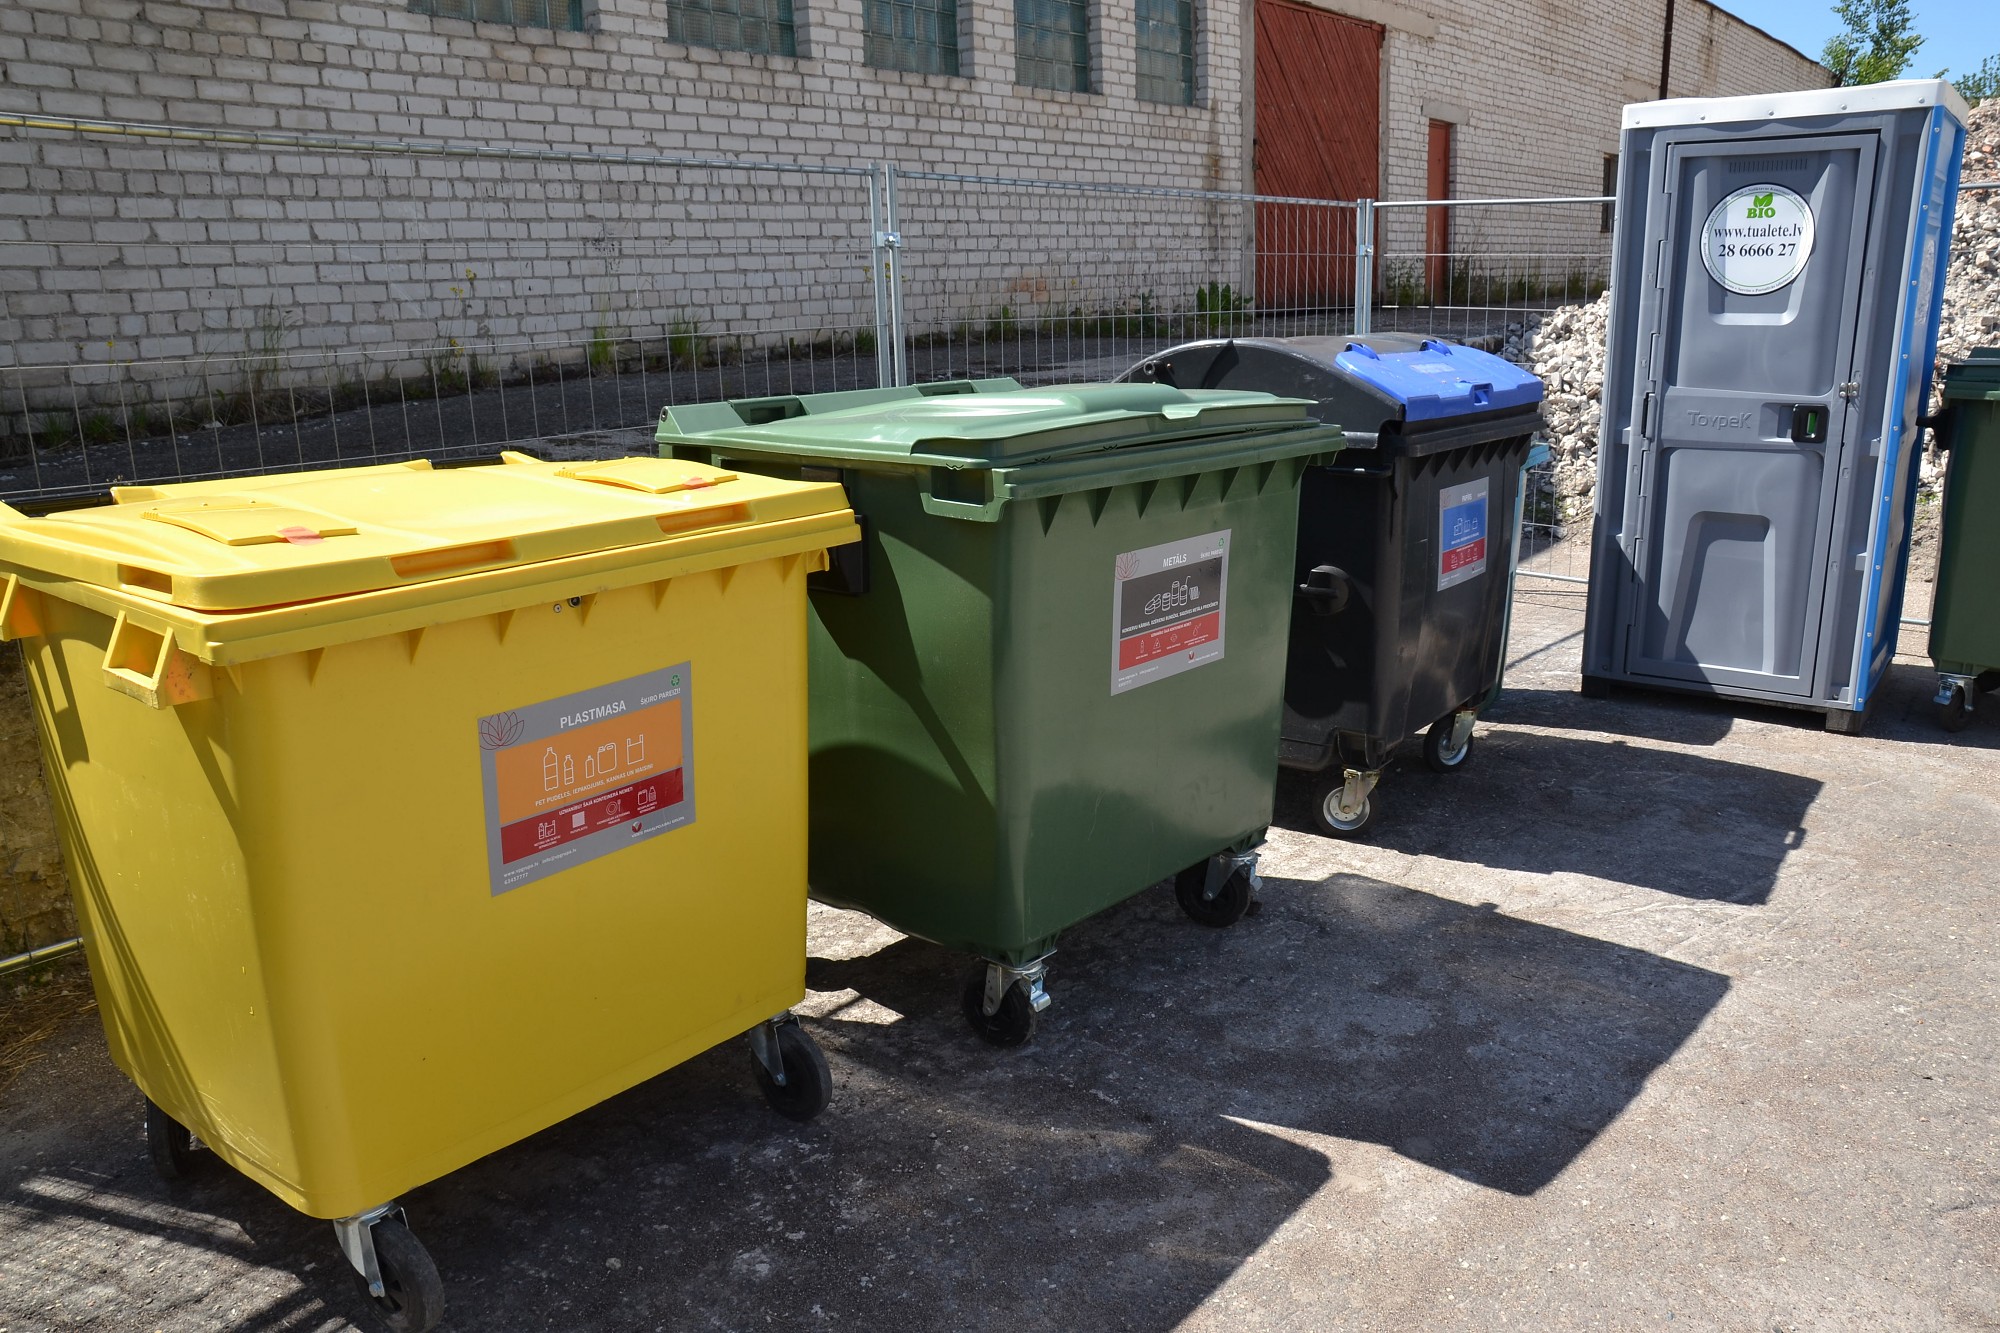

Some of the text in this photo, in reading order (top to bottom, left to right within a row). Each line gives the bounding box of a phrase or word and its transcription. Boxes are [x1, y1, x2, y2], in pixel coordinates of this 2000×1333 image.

[1746, 207, 1776, 219] BIO
[1714, 223, 1804, 238] www.tualete.lv
[1718, 243, 1736, 257] 28
[1739, 243, 1774, 257] 6666
[1777, 243, 1796, 257] 27
[1162, 553, 1187, 568] METĀLS
[640, 694, 658, 705] ŠĶIRO
[560, 700, 626, 728] PLASTMASA
[535, 798, 546, 807] PET
[606, 772, 626, 784] KANNAS
[626, 770, 635, 778] UN
